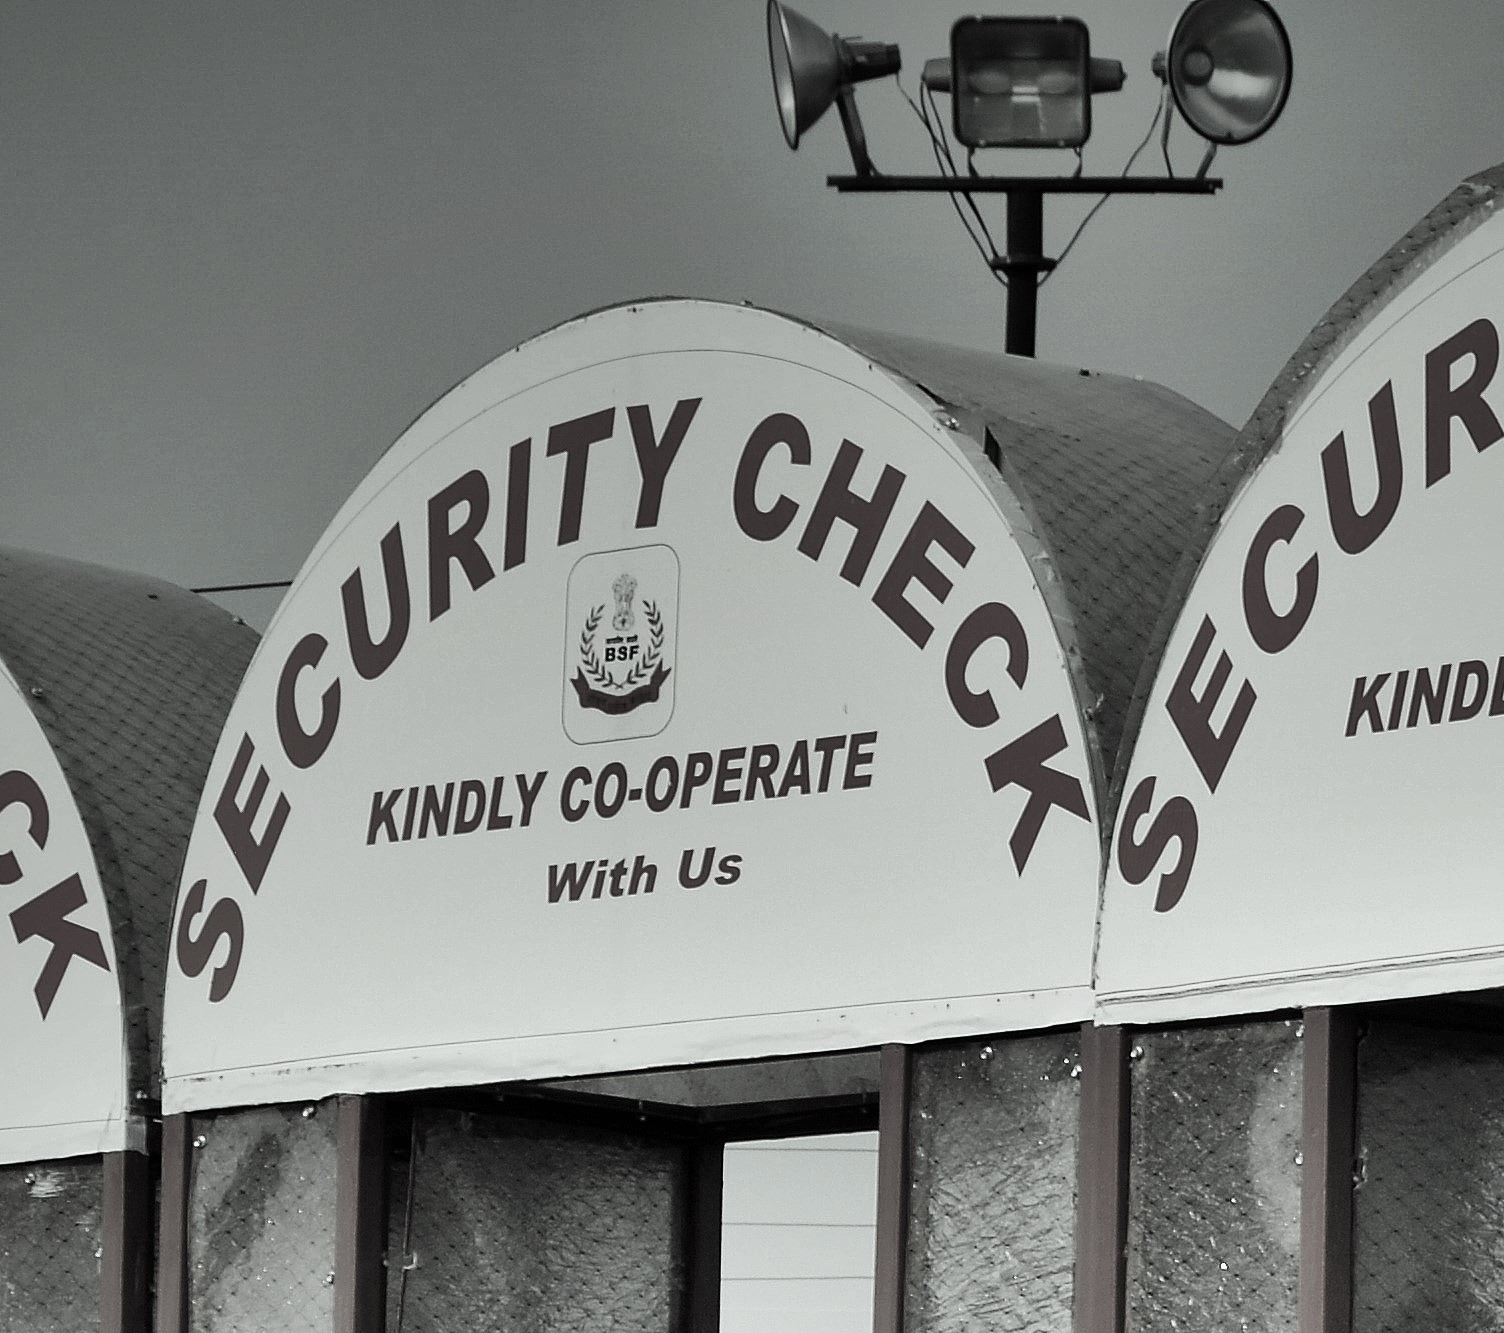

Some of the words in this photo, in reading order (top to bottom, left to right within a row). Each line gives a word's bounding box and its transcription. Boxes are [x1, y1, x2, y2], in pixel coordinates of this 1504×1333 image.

[604, 644, 640, 662] BSF
[177, 398, 702, 1002] SECURITY
[734, 413, 1091, 877] CHECK
[367, 770, 549, 846] KINDLY
[560, 730, 877, 823] CO-OPERATE
[548, 855, 658, 904] With
[678, 846, 743, 889] Us
